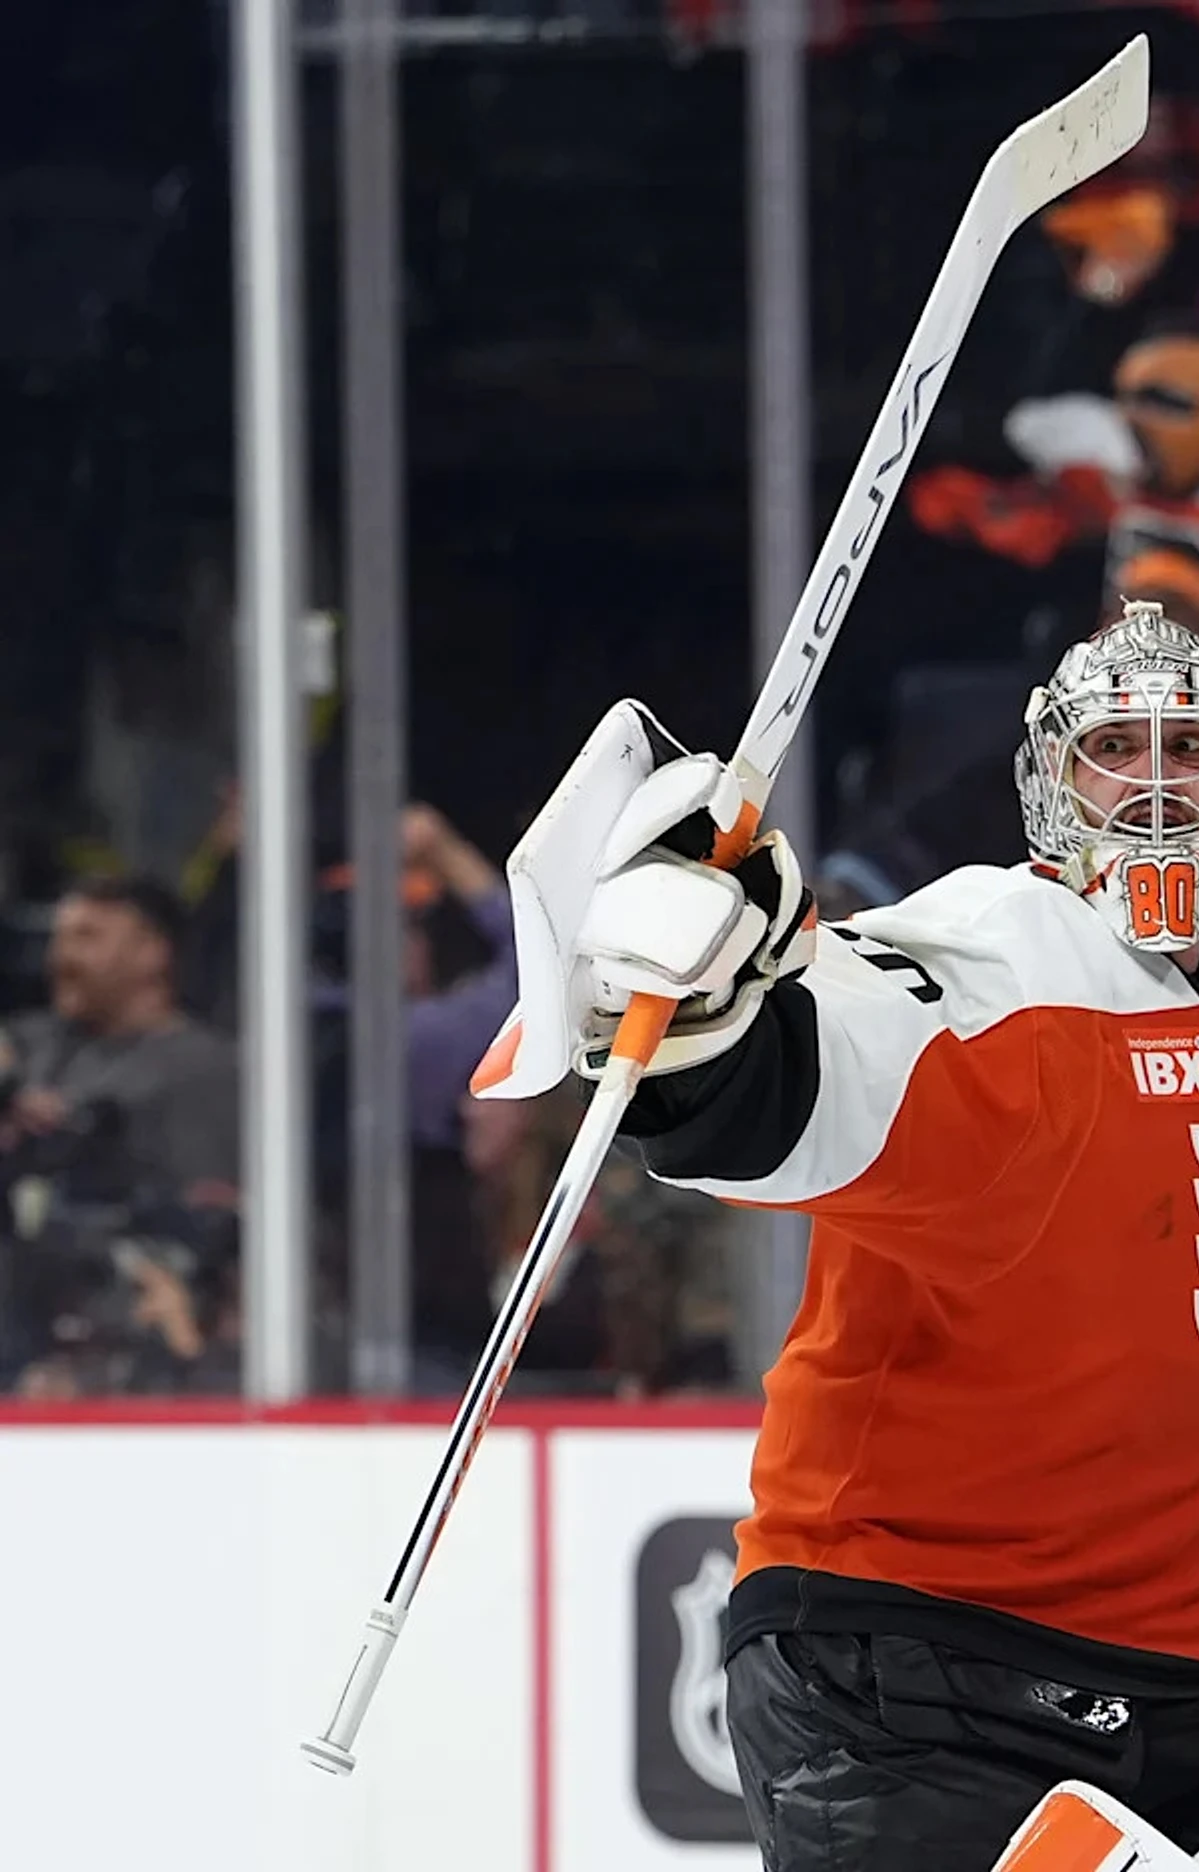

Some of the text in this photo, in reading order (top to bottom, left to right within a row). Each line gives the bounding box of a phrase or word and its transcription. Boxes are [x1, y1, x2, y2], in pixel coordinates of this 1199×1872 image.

[757, 349, 952, 741] VAPOR
[1127, 862, 1196, 938] 80
[1127, 1036, 1194, 1050] Independence
